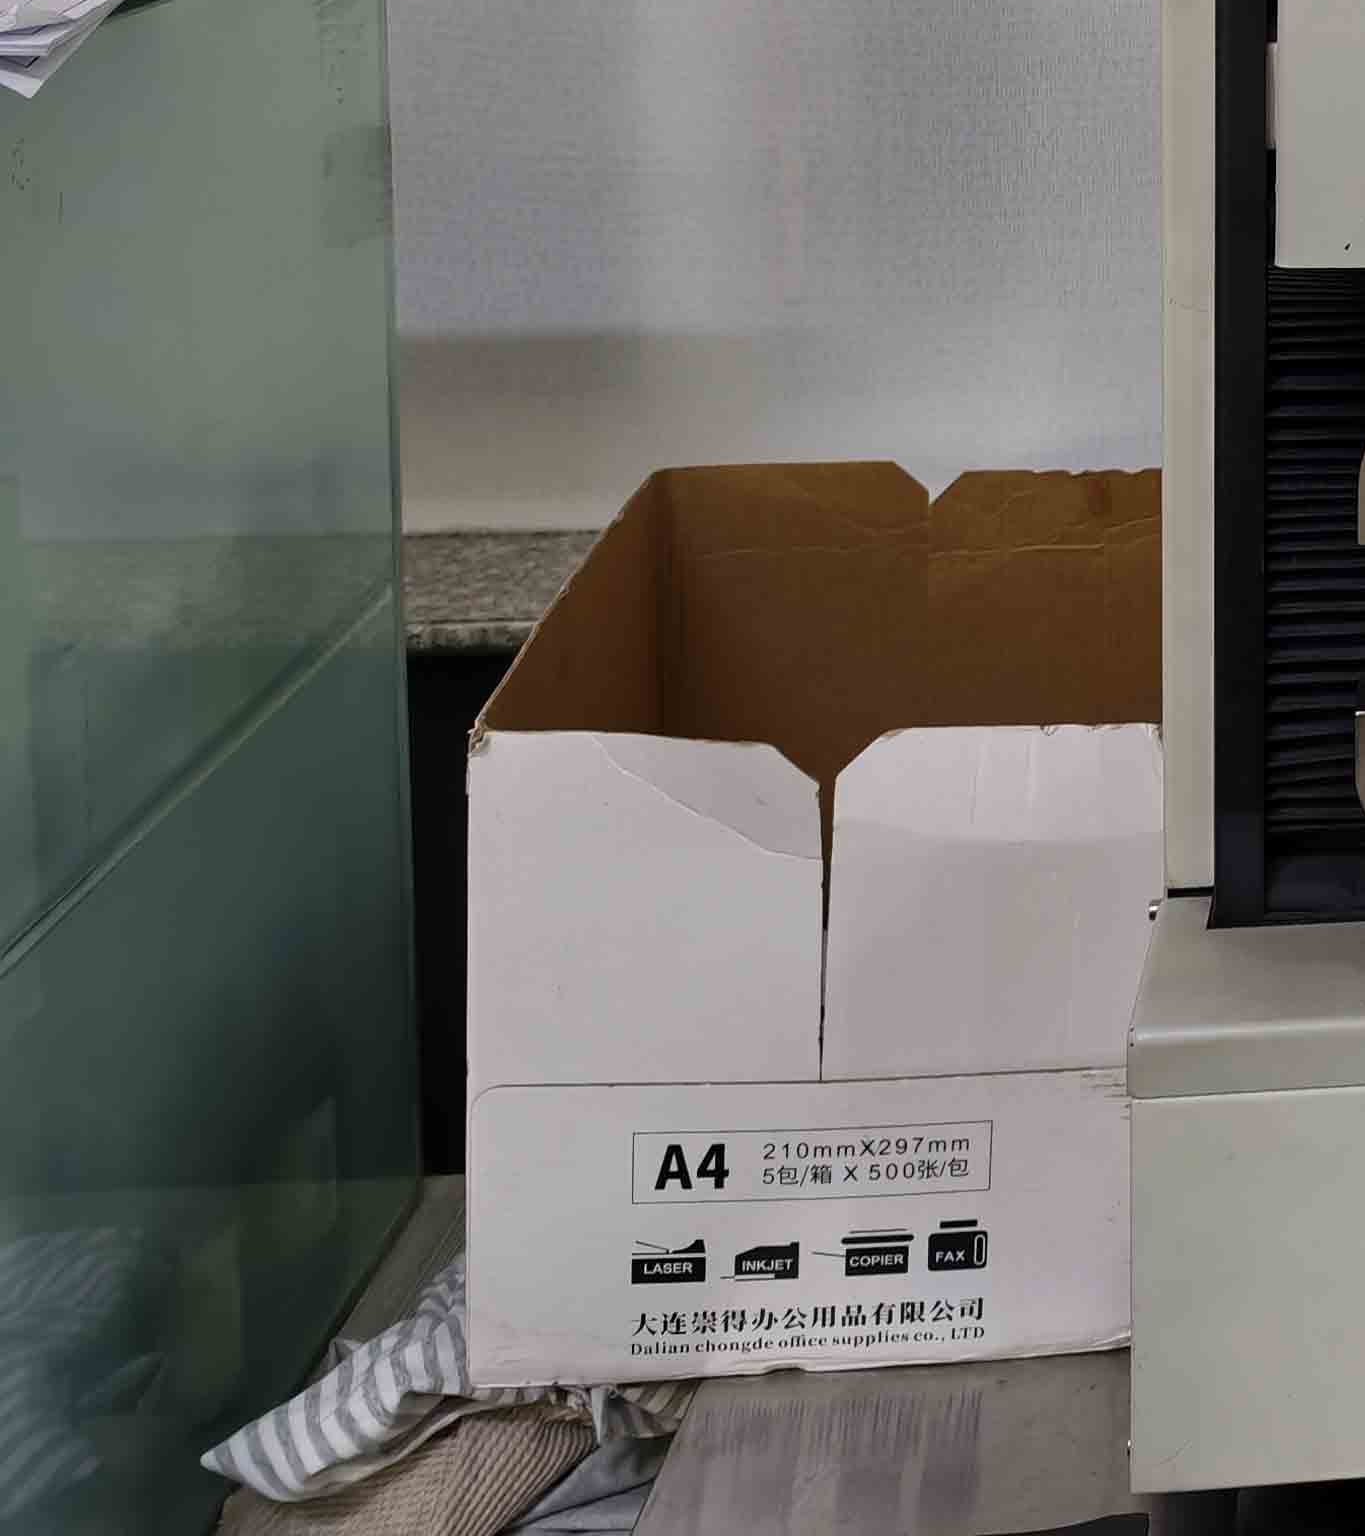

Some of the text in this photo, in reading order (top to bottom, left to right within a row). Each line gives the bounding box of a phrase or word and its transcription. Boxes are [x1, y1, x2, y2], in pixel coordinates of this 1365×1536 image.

[654, 1143, 730, 1191] A4
[643, 1249, 965, 1275] LASER INKJET COPIER FAX
[632, 1297, 985, 1336] 大连崇得办公用品有限公司
[630, 1340, 690, 1356] Dalian
[694, 1337, 774, 1354] chongde
[778, 1333, 828, 1349] office
[832, 1328, 910, 1350] supplies
[950, 1326, 985, 1340] LTD
